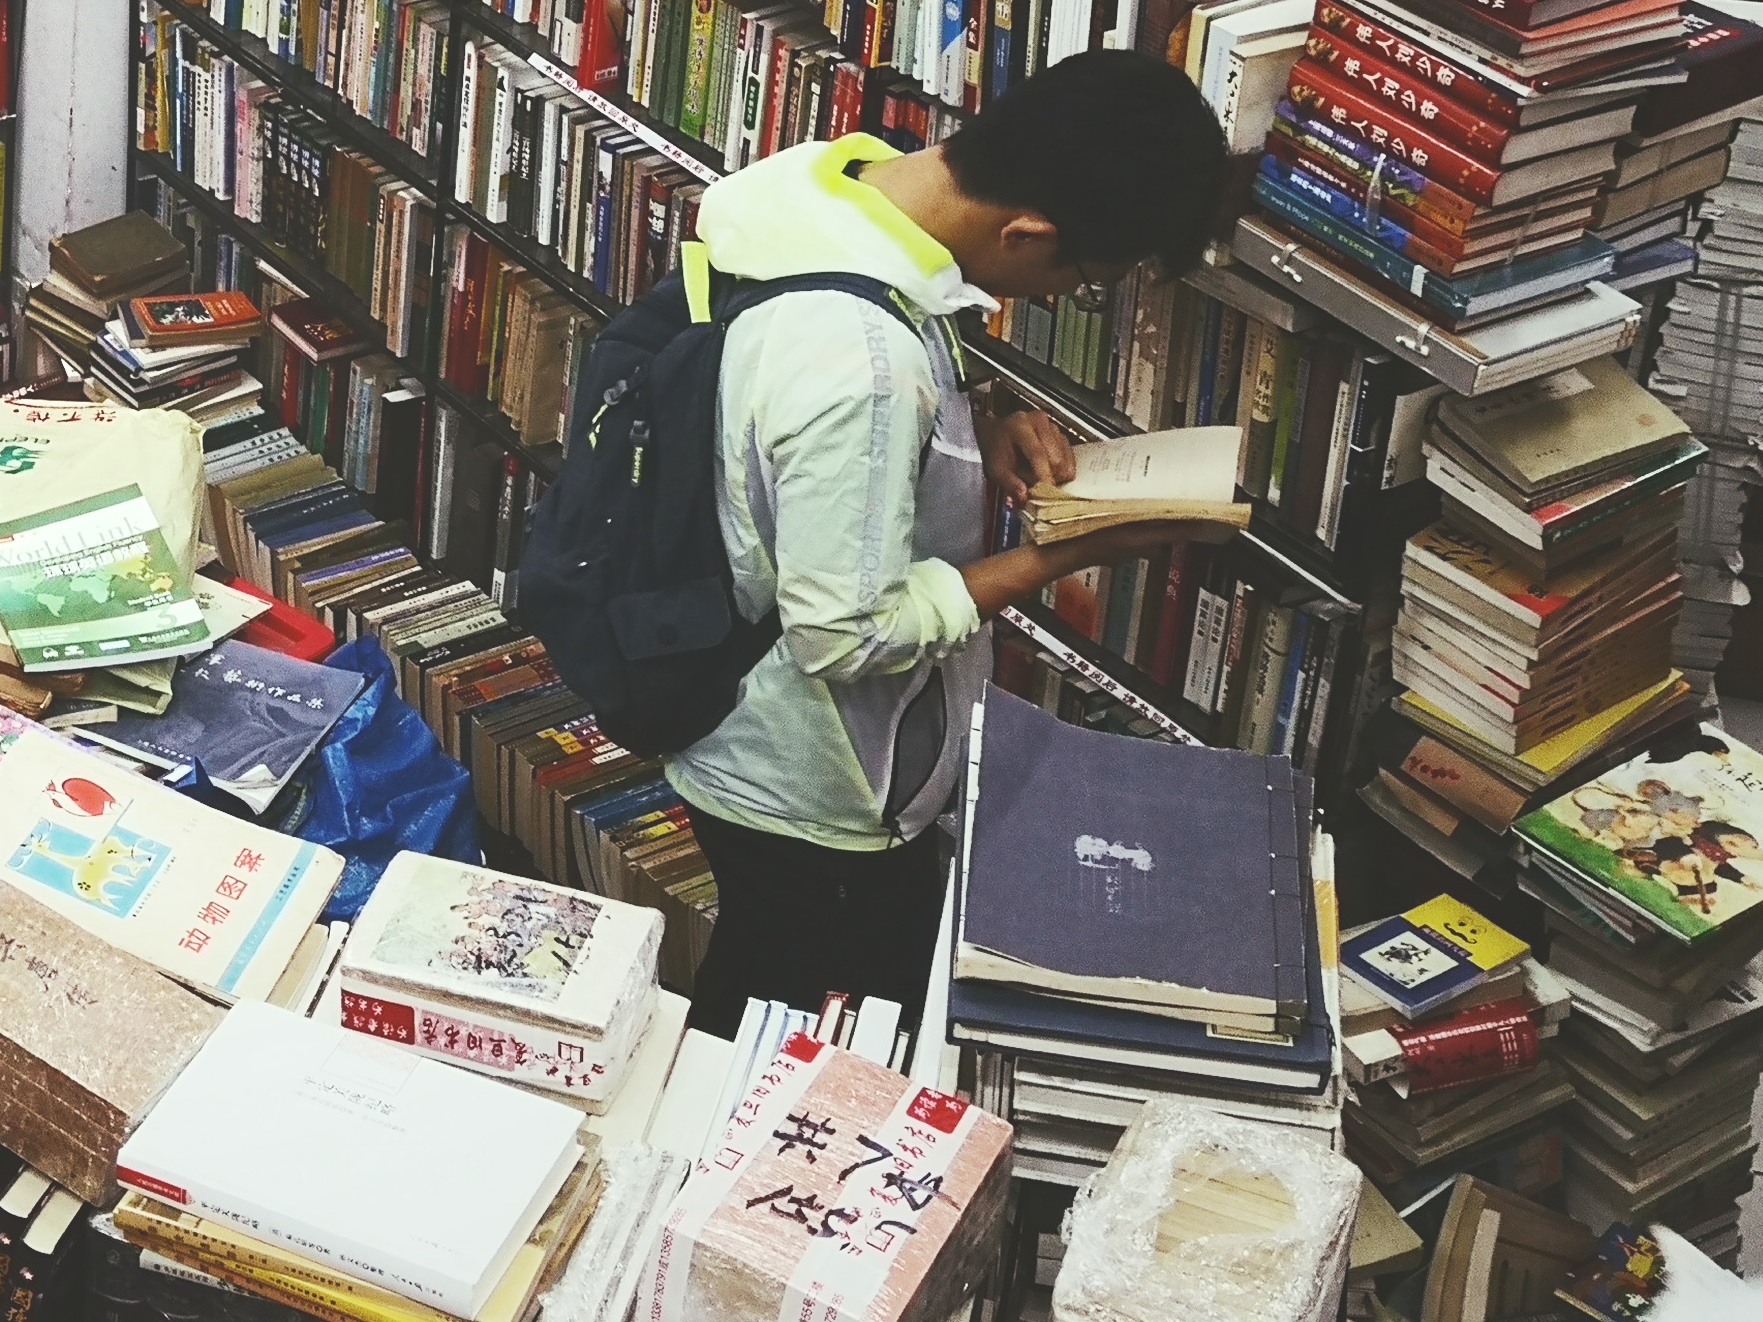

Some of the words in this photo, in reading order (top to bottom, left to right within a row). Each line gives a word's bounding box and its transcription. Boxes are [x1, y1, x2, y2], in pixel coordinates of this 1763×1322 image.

[1355, 23, 1459, 87] 伟人刘少奇
[1343, 57, 1439, 120] 伟人刘少奇
[1330, 104, 1429, 167] 伟人刘少奇
